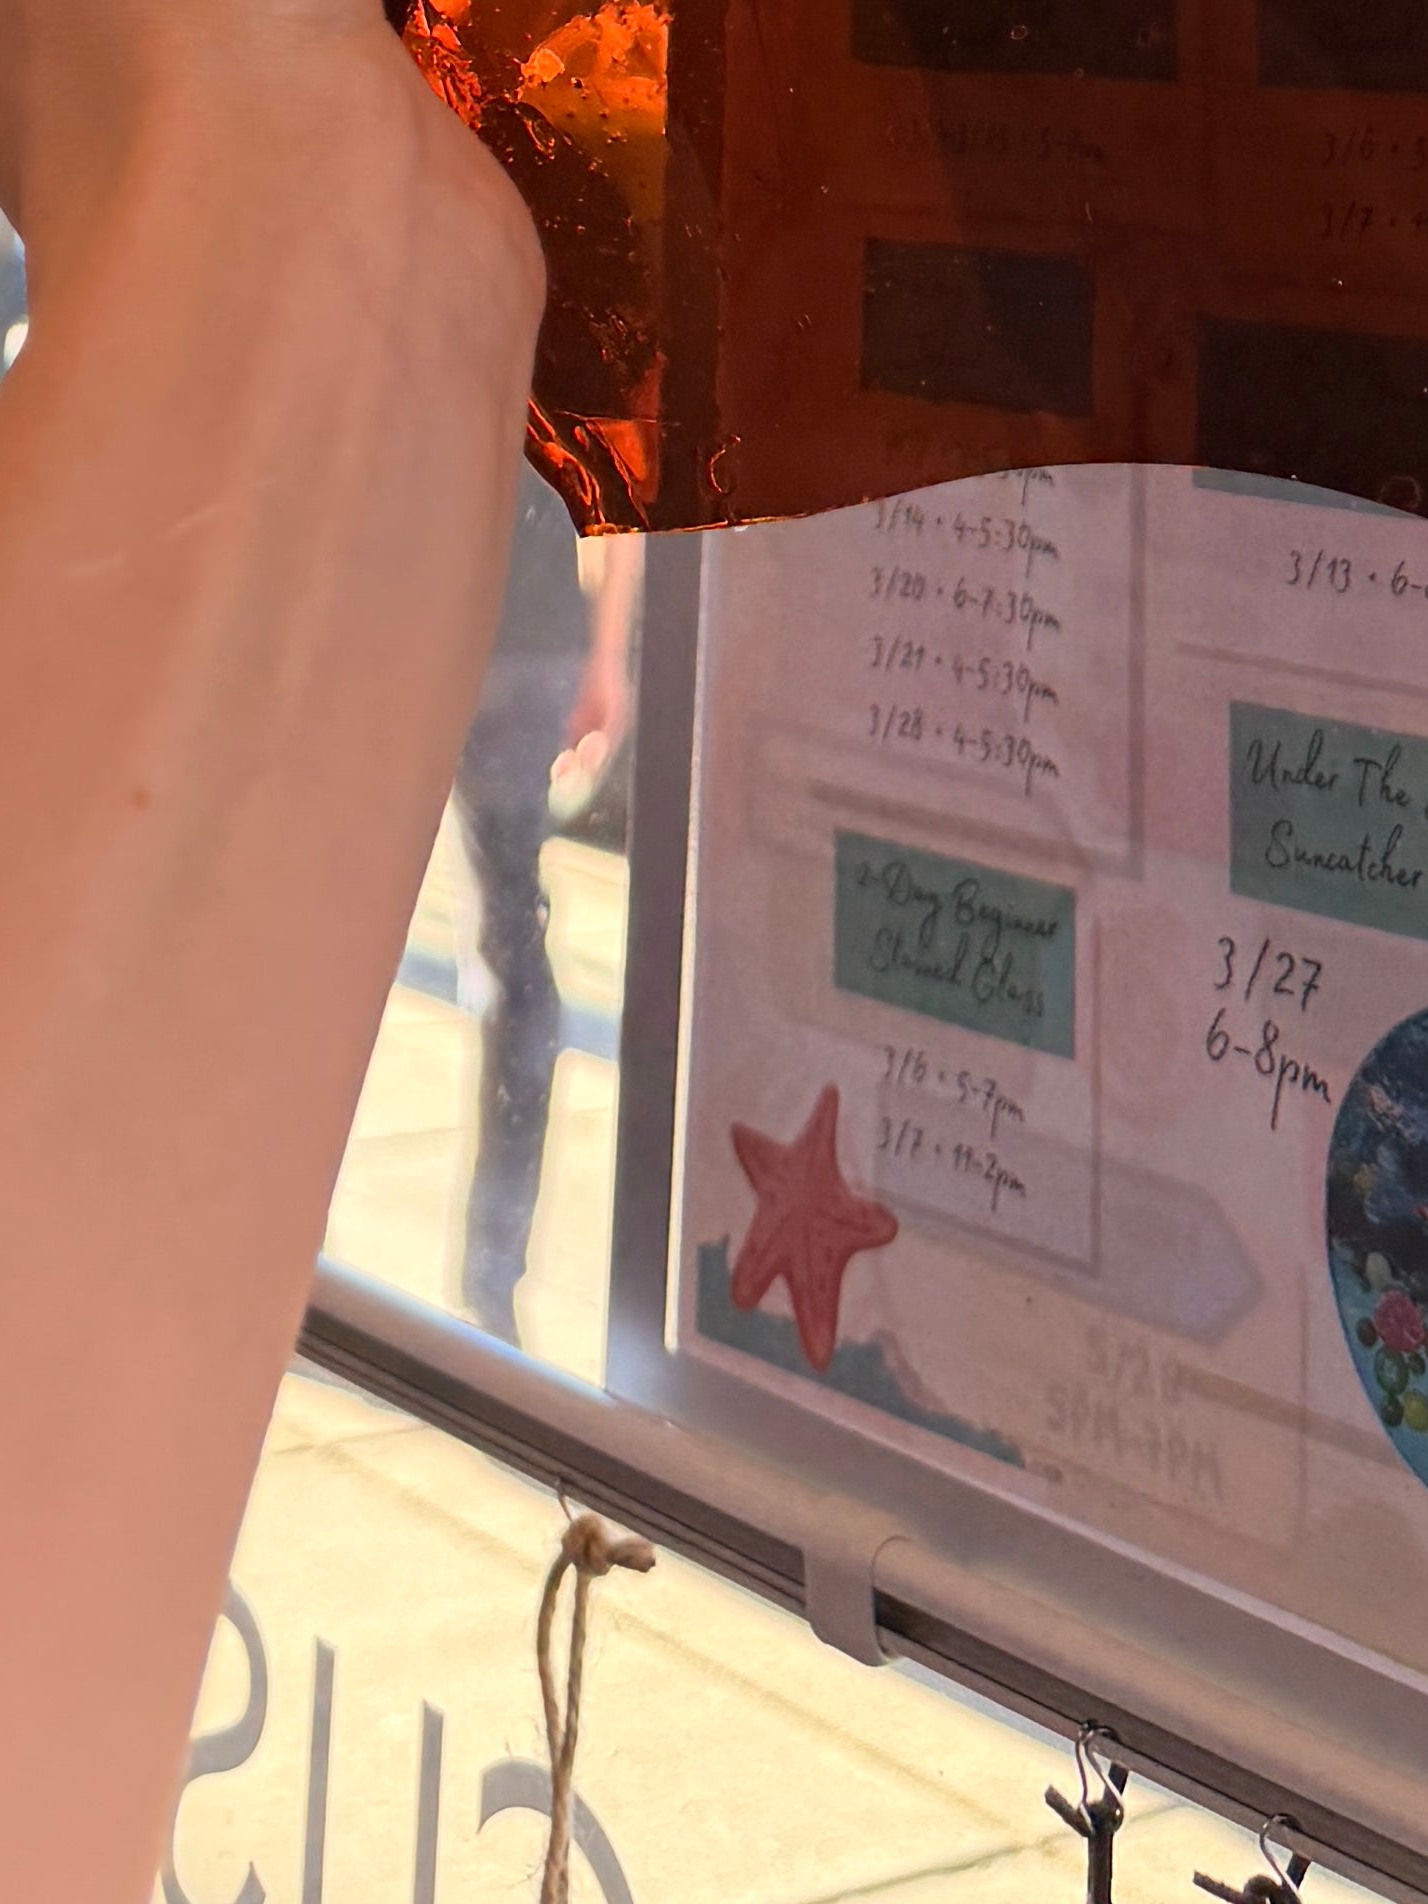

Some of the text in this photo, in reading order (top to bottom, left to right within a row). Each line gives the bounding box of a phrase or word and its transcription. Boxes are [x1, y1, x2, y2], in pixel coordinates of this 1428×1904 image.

[870, 565, 1062, 651] 3/20 6-7:30pm
[1287, 549, 1352, 594] 3/13
[952, 656, 1060, 724] 4-5:30pm
[869, 704, 1060, 797] 3/28 4-5:30pm
[1246, 729, 1341, 790] Under
[1354, 743, 1410, 809] The
[1265, 820, 1423, 890] Suncatcher
[1214, 937, 1323, 1013] 3/27
[956, 1070, 1025, 1141] 5-7pm
[1205, 1008, 1332, 1132] 6-8pm
[878, 1116, 924, 1158] 3/7
